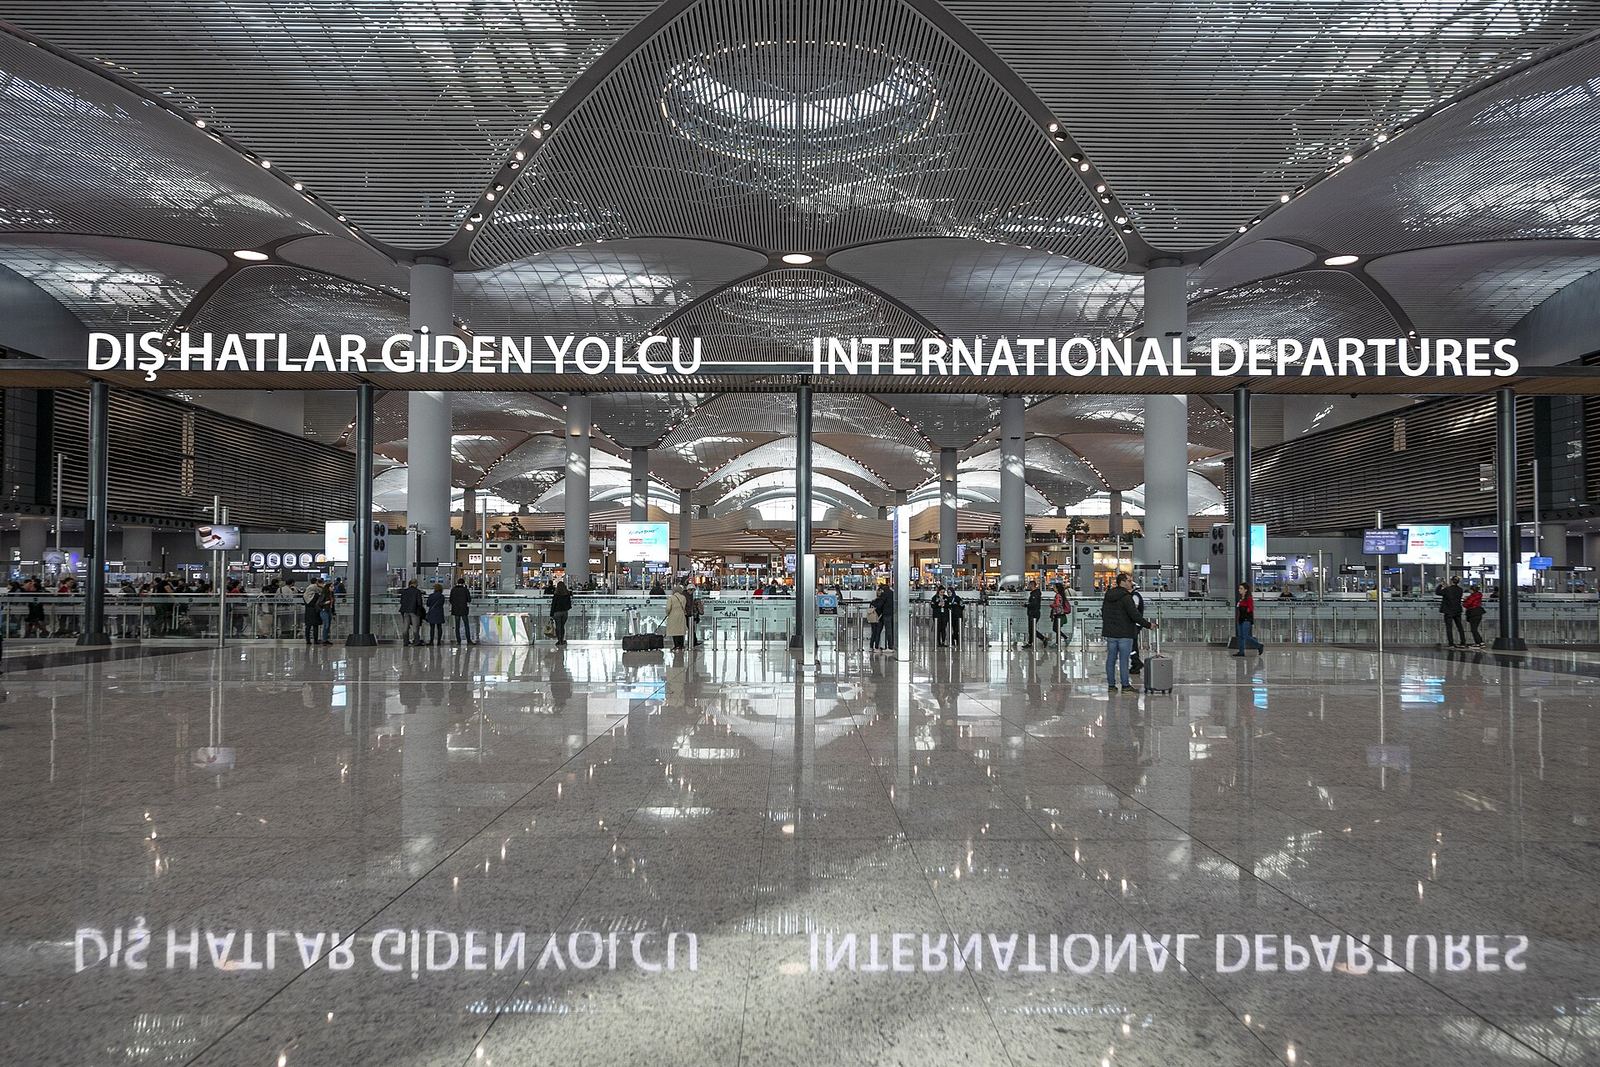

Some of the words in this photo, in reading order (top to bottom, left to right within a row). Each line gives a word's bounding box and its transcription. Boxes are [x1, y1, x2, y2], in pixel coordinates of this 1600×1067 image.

[87, 332, 166, 381] DIŞ
[180, 333, 367, 372] HATLAR
[381, 326, 532, 375] GİDEN
[544, 335, 702, 375] YOLCU
[812, 337, 1197, 378] INTERNATIONAL
[1210, 337, 1520, 378] DEPARTURES
